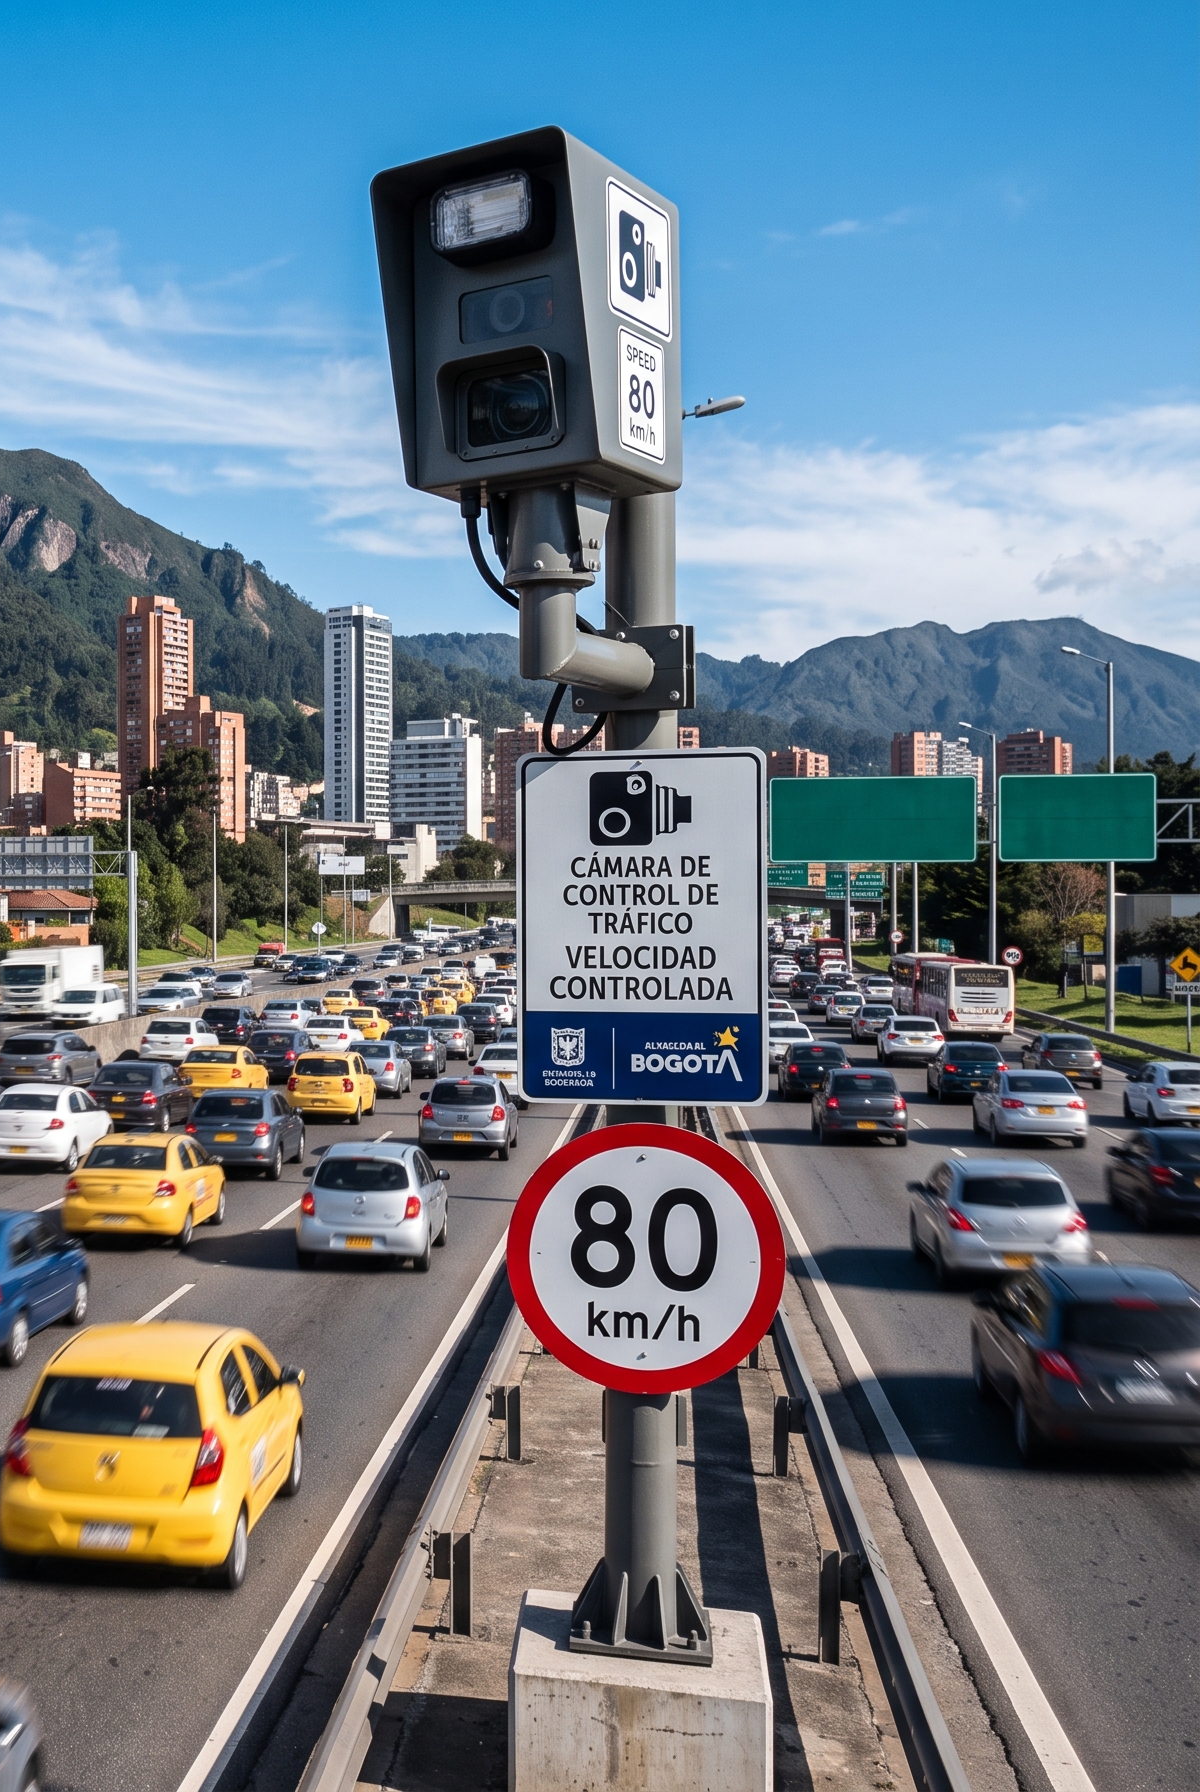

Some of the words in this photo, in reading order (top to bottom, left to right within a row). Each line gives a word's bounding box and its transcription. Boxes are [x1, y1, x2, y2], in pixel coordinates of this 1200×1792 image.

[626, 343, 657, 372] SPEED
[628, 373, 655, 419] 80
[629, 416, 656, 446] km/h
[570, 851, 673, 878] CÁMARA
[680, 855, 711, 877] DE
[563, 883, 680, 906] CONTROL
[688, 883, 719, 906] DE
[587, 907, 693, 935] TRÁFICO
[565, 945, 717, 970] VELOCIDAD
[549, 975, 734, 1001] CONTROLADA
[570, 1184, 718, 1292] 80
[587, 1301, 700, 1343] km/h
